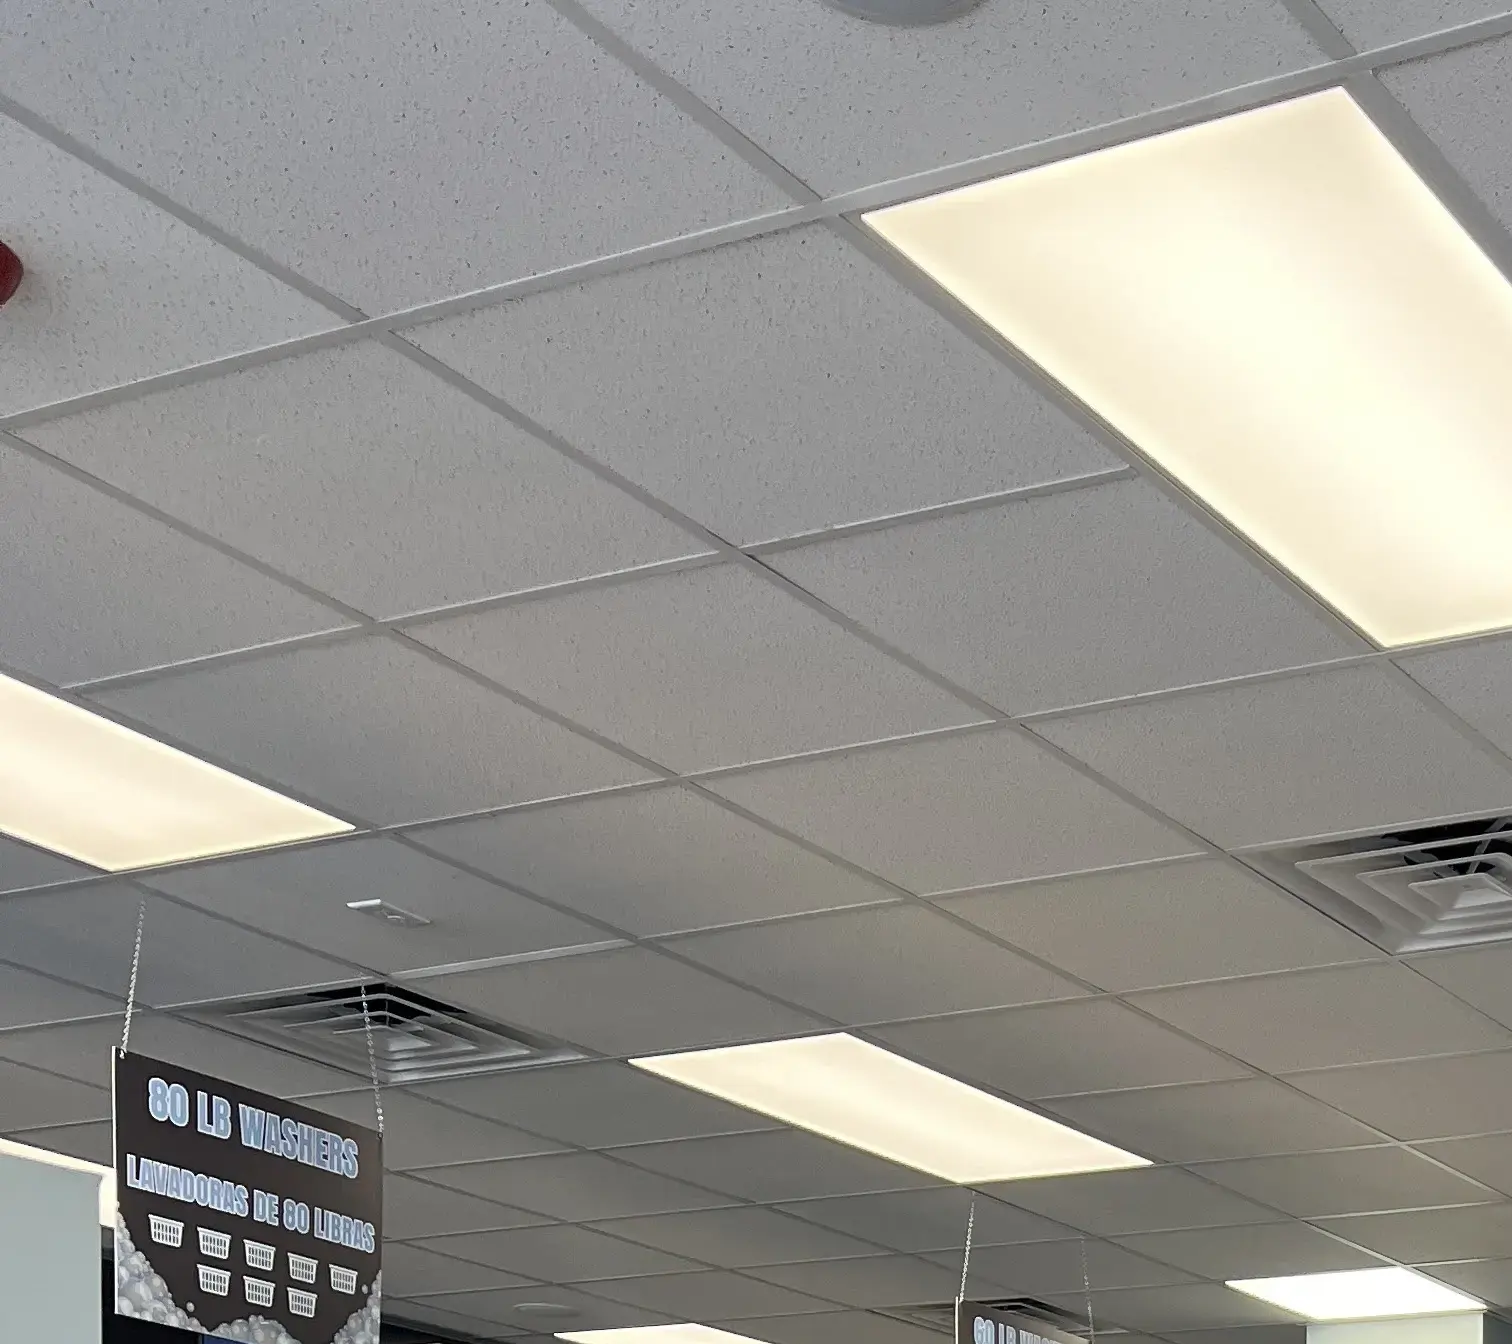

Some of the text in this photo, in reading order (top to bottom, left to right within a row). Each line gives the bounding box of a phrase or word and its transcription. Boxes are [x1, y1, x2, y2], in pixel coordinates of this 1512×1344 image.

[148, 1077, 359, 1178] 80 LB WASHERS
[126, 1153, 375, 1253] LAVADORAS DE 80 LIBRAS
